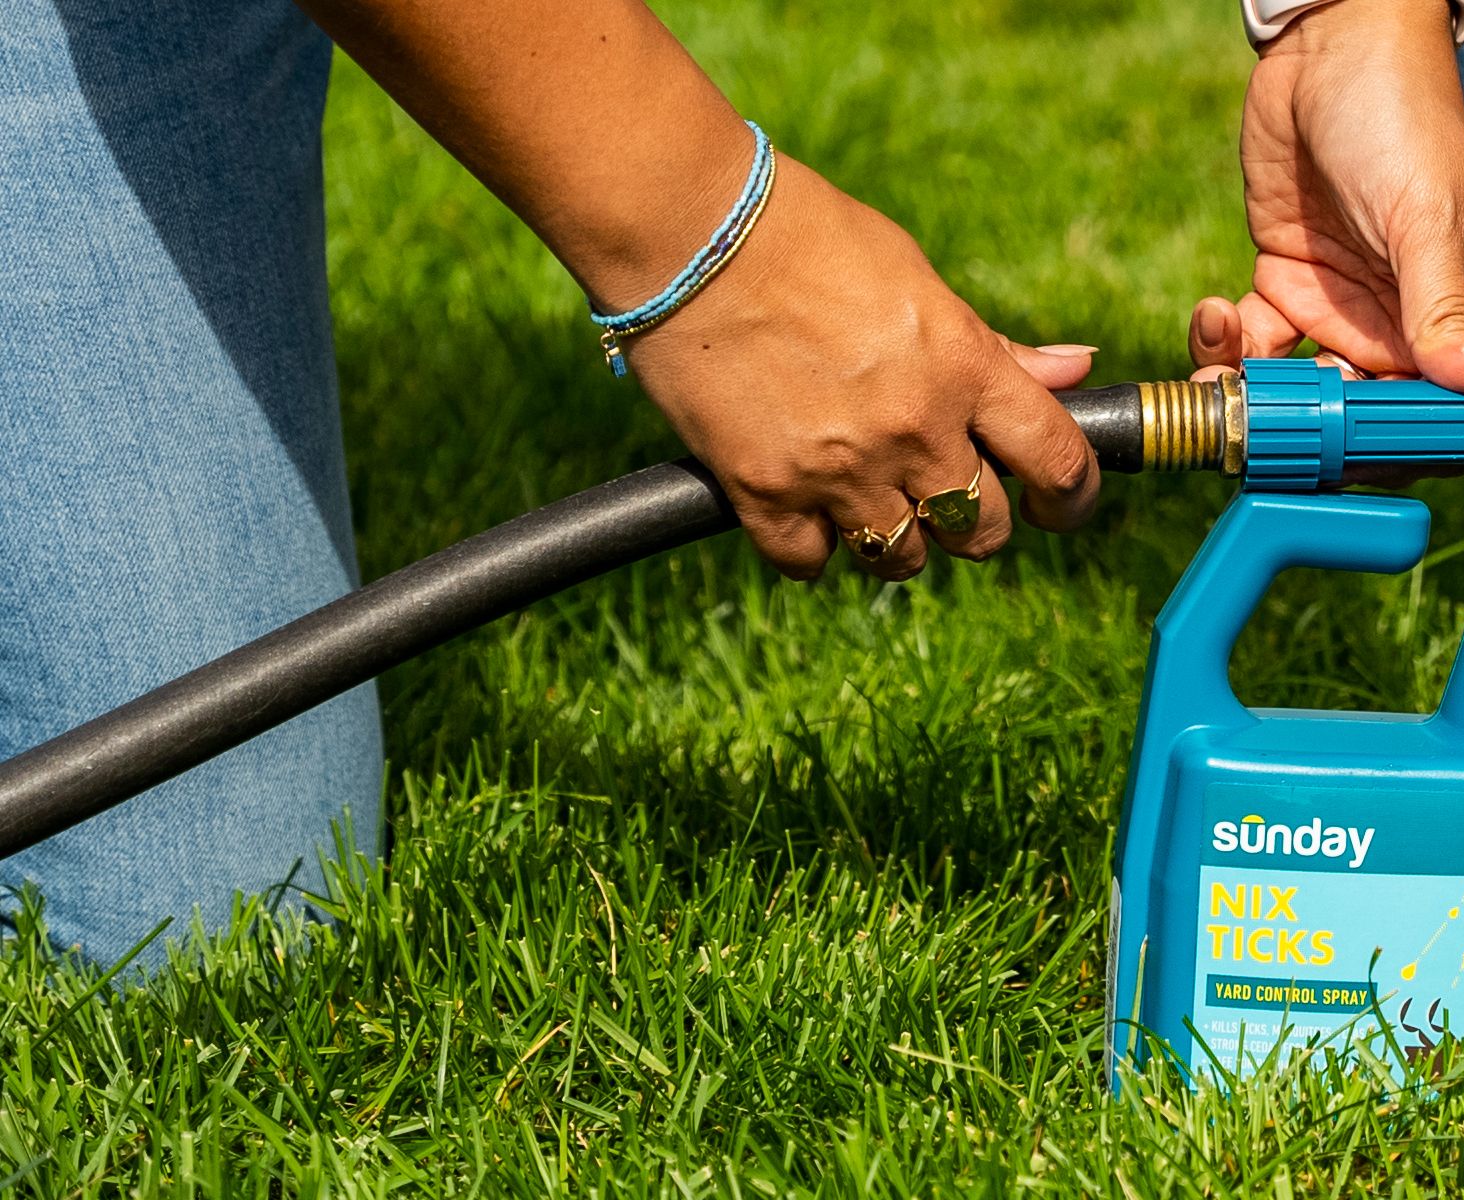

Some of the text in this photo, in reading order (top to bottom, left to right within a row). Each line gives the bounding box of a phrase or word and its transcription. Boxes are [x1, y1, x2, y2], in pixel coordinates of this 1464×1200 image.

[1212, 814, 1375, 868] sunday
[1211, 883, 1298, 921] NIX
[1206, 925, 1335, 965] TICKS
[1215, 982, 1368, 1006] YARD CONTROL SPRAY
[1211, 1020, 1238, 1034] KILLS
[1242, 1022, 1269, 1036] ICKS,
